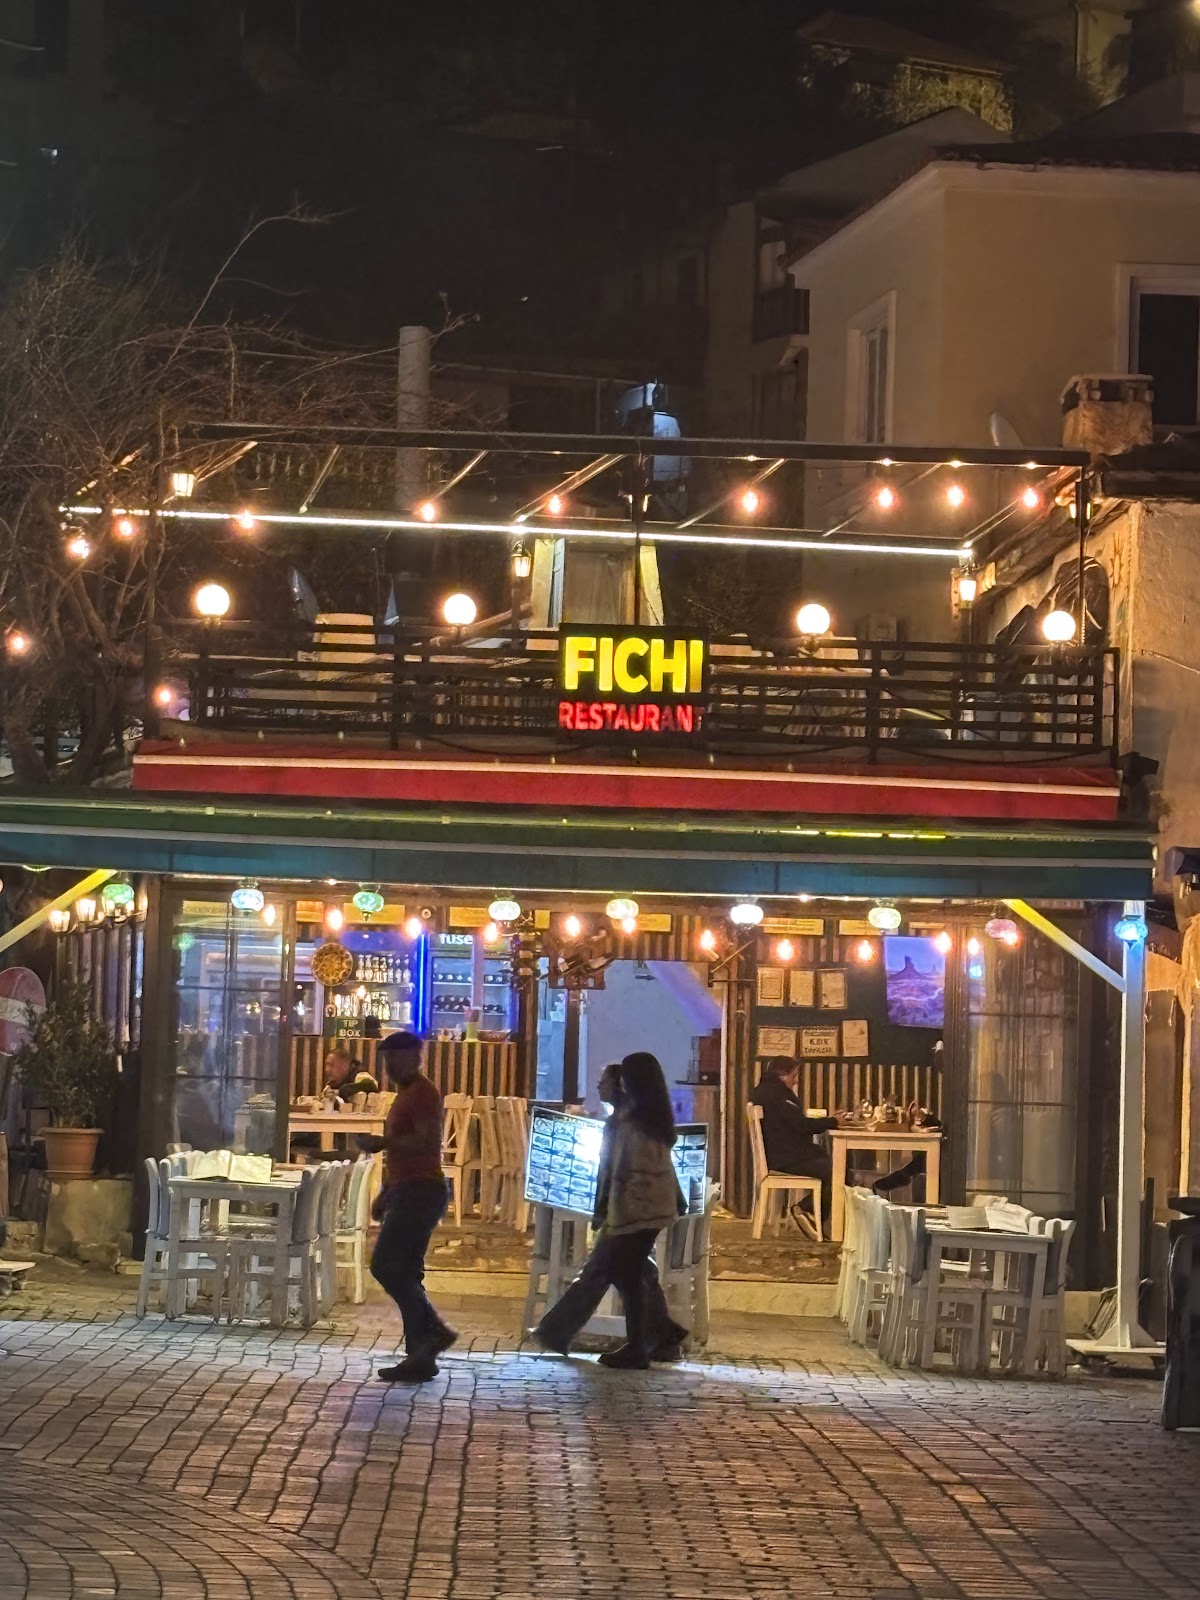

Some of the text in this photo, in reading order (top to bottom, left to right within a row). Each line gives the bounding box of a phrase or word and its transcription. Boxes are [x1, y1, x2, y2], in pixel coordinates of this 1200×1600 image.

[565, 636, 703, 693] FICHI
[342, 1019, 359, 1028] TIP
[339, 1028, 361, 1037] BOX
